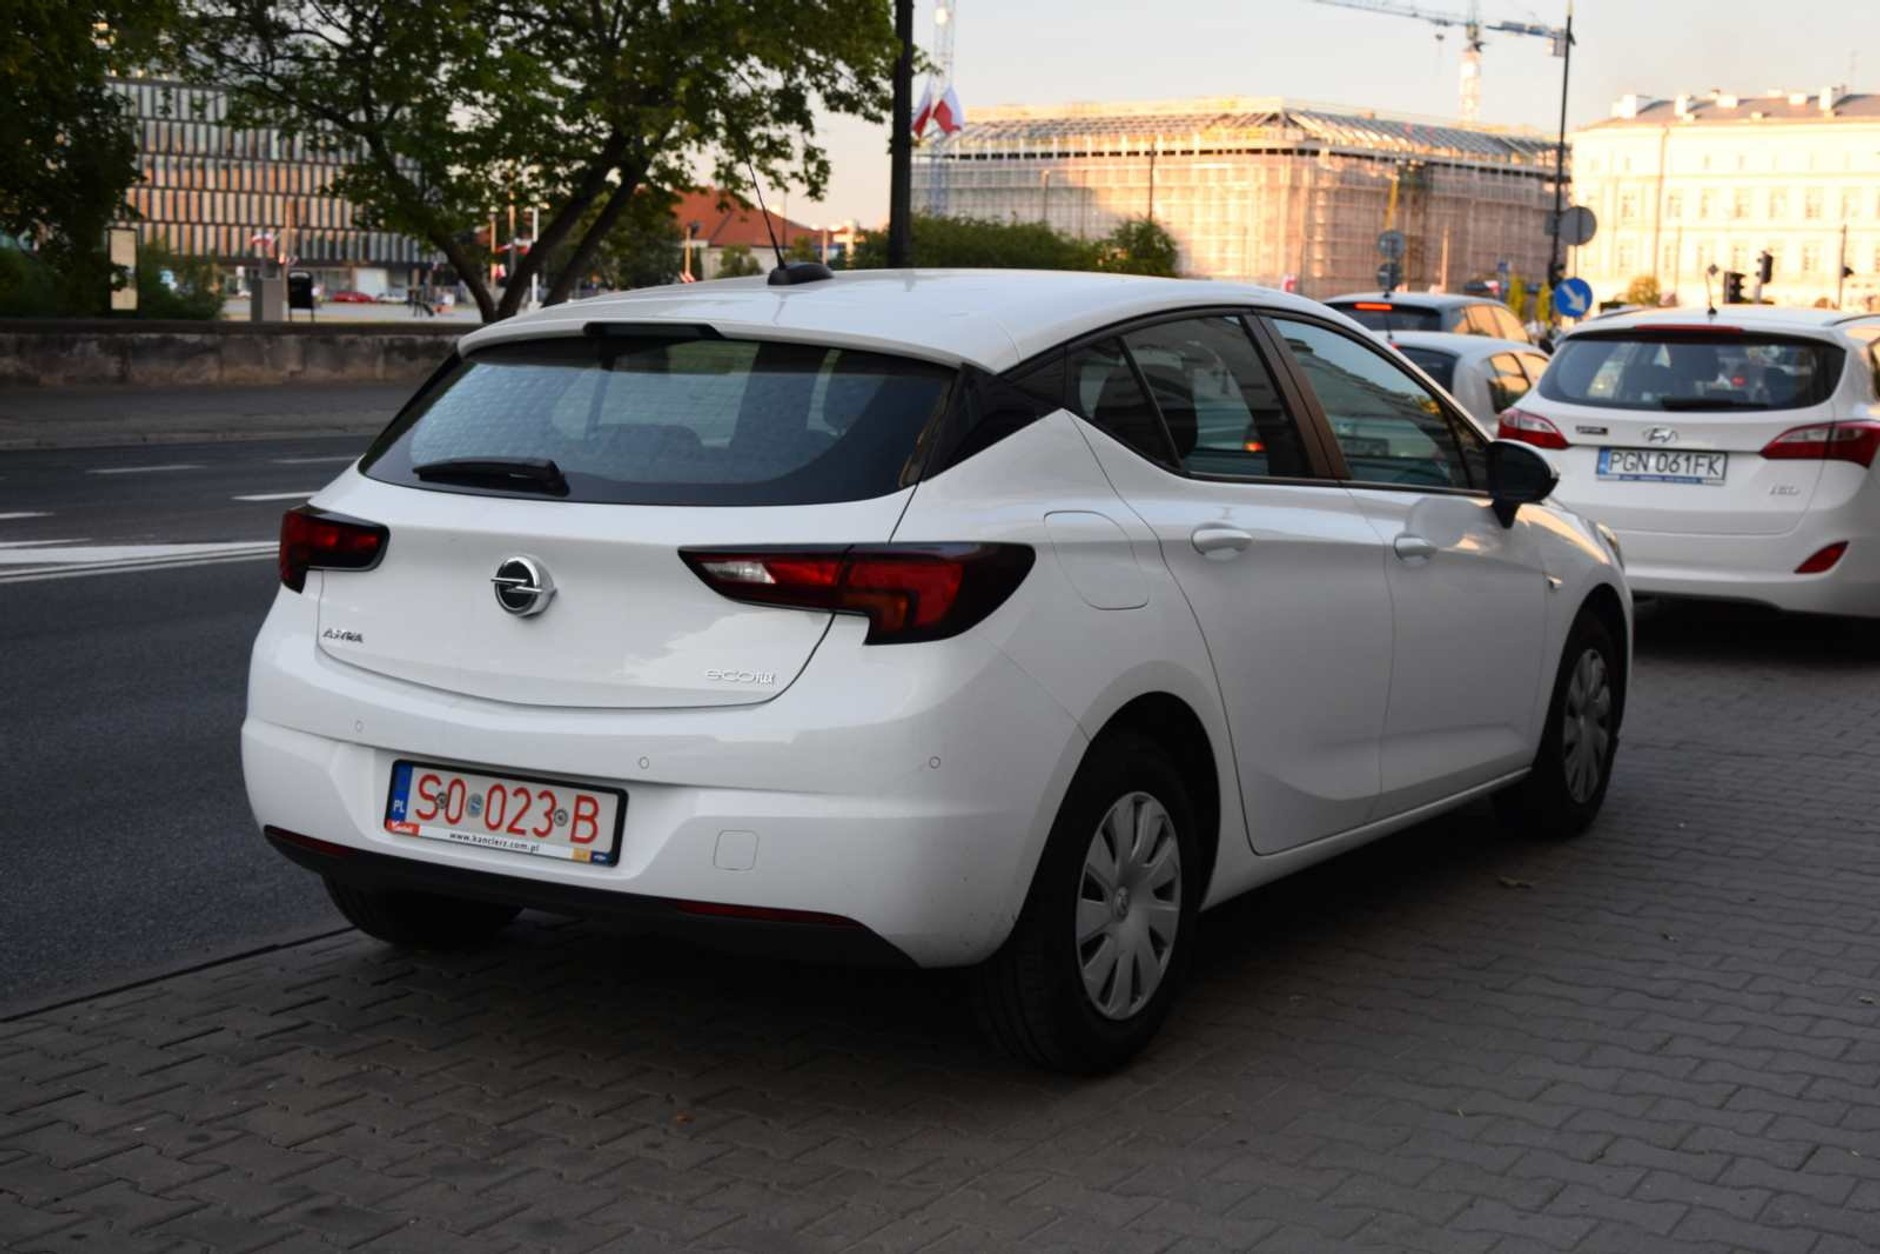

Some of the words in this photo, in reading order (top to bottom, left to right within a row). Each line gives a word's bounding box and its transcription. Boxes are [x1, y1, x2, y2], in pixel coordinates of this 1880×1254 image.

[1609, 451, 1650, 473] PGN
[1655, 452, 1721, 476] 061FK
[393, 798, 405, 814] PL
[484, 783, 558, 839] 023
[569, 794, 600, 845] B
